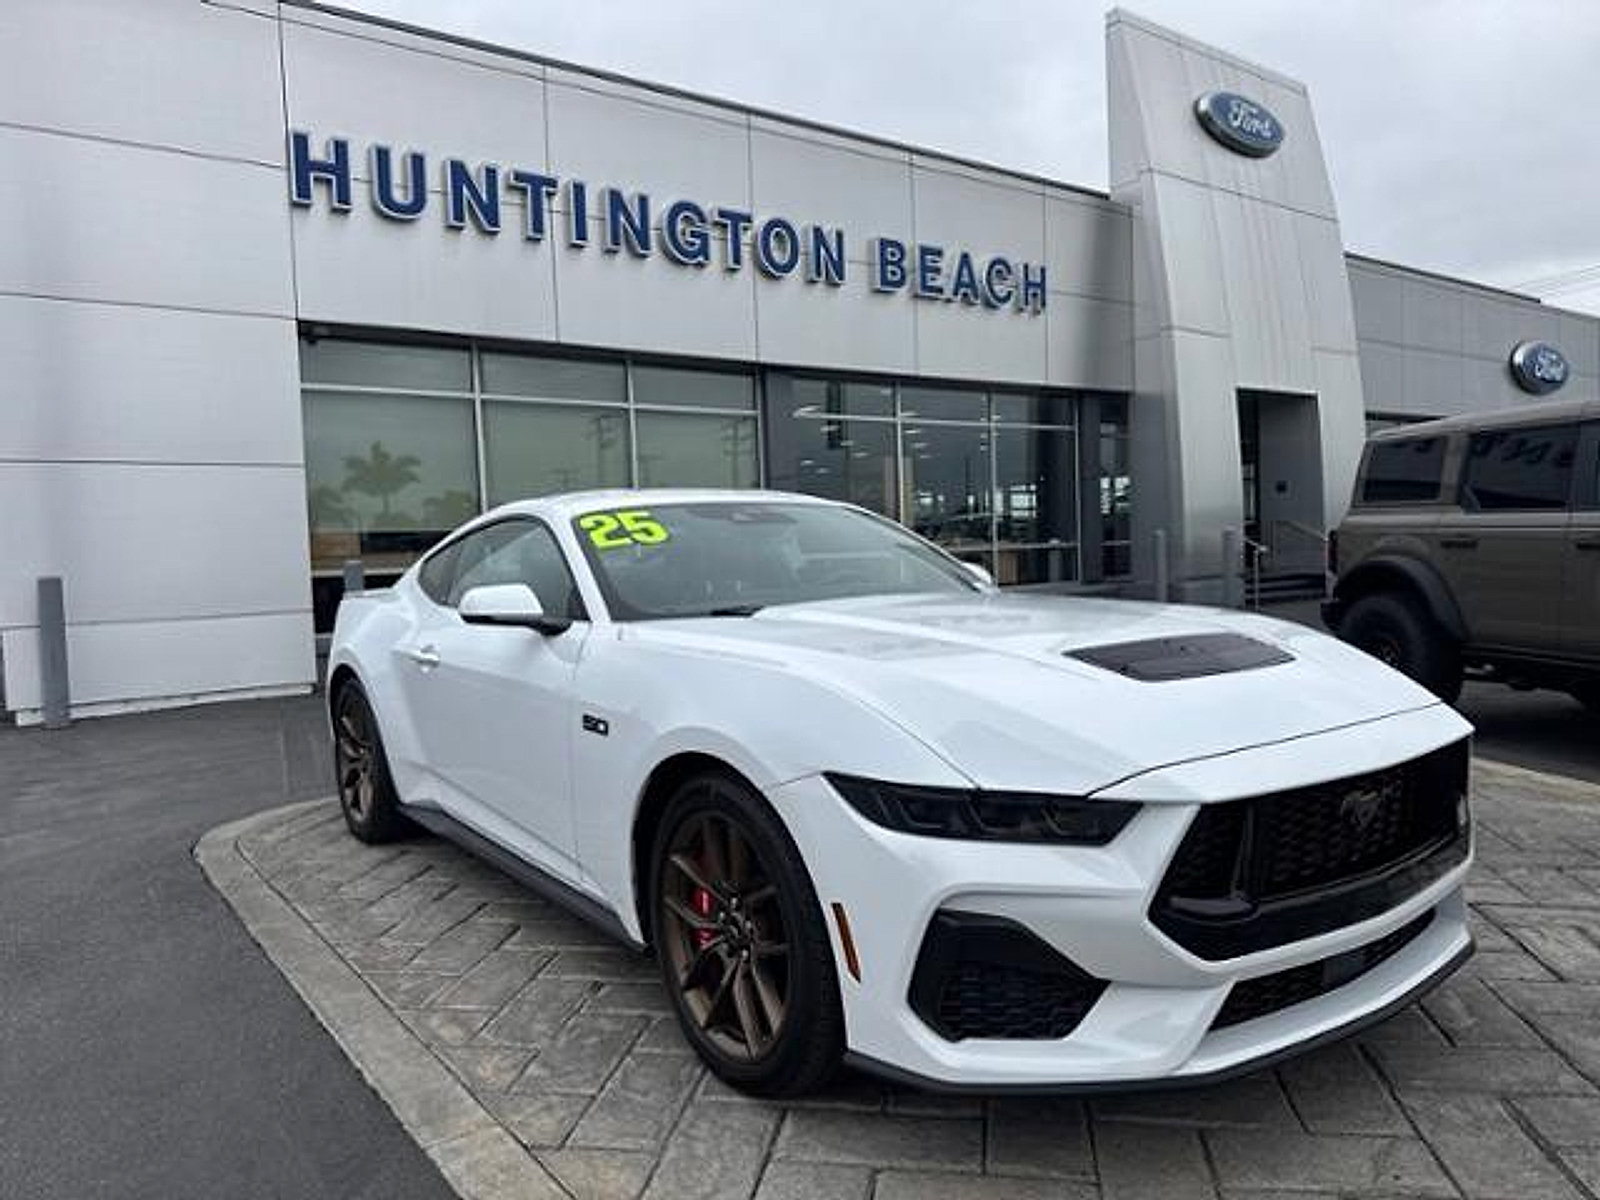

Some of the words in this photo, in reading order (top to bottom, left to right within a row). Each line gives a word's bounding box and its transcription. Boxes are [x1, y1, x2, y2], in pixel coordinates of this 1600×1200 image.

[1227, 100, 1273, 138] Ford
[290, 130, 846, 286] HUNTINGTON
[874, 236, 1048, 314] BEACH
[580, 511, 668, 547] 25
